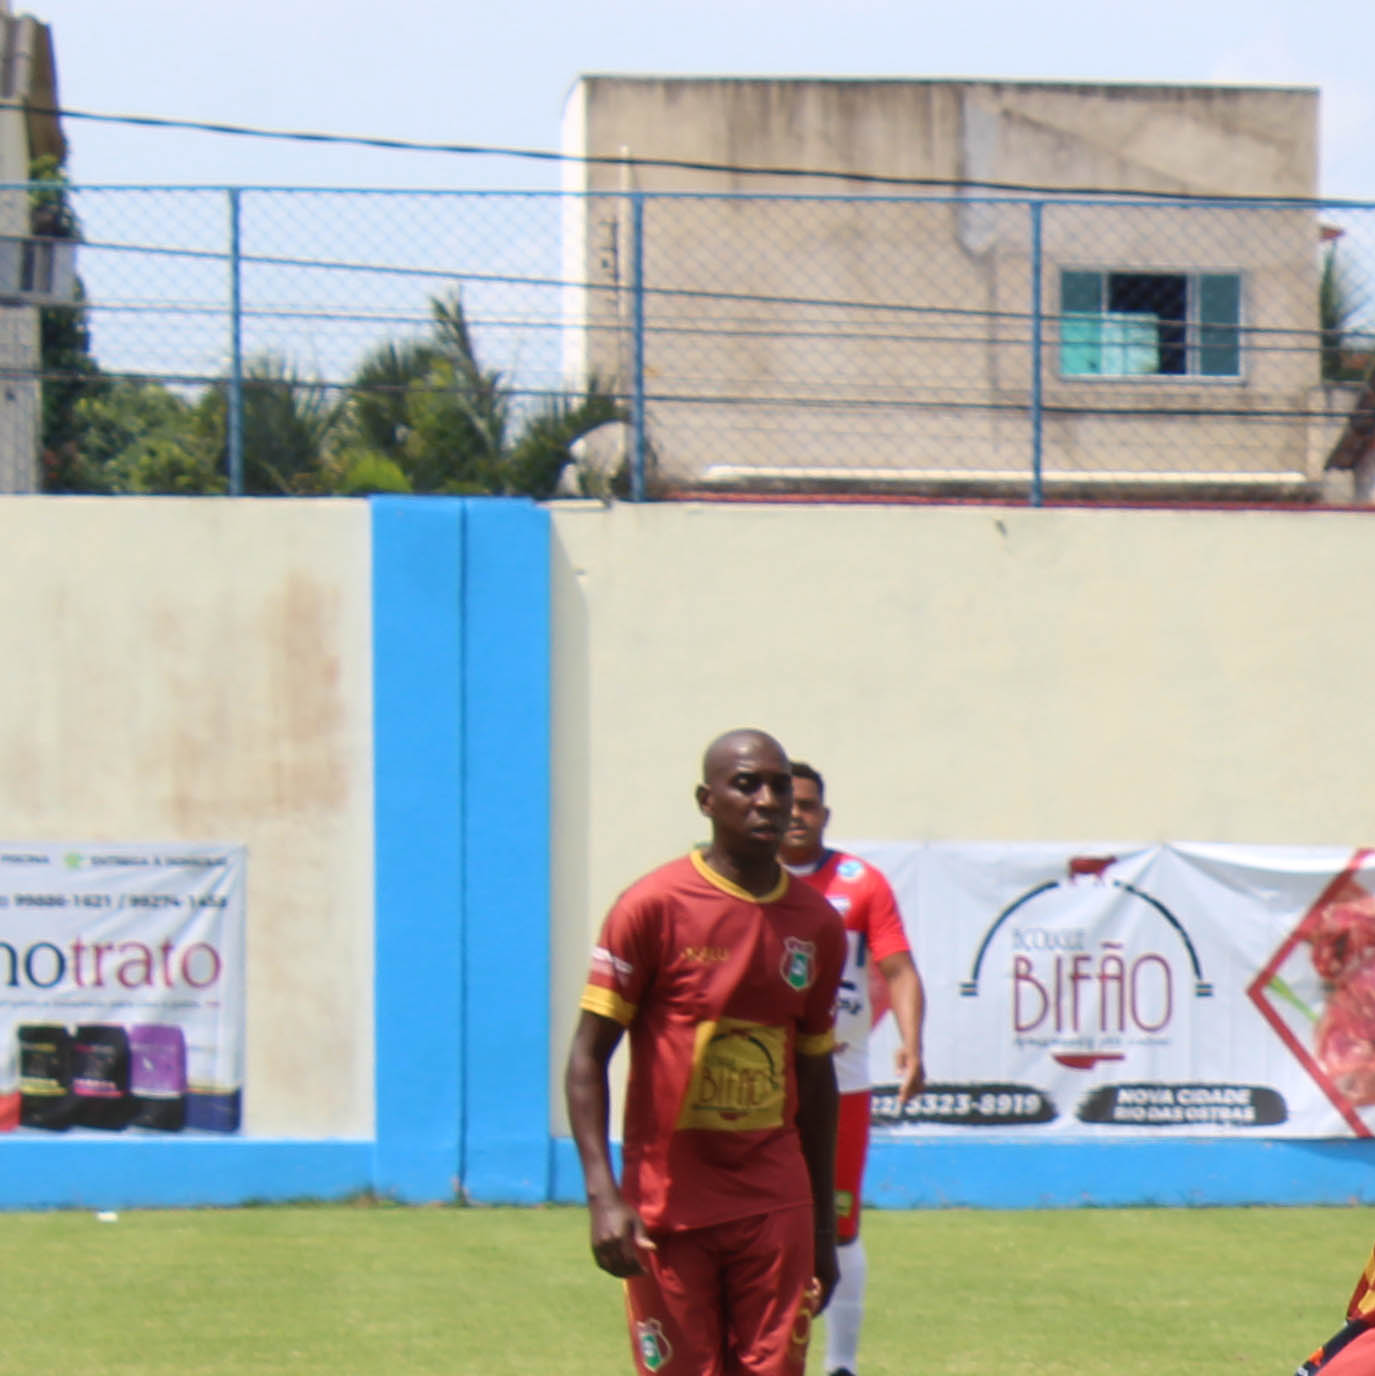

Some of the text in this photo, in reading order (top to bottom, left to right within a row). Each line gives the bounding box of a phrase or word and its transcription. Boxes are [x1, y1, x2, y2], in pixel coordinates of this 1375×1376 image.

[1014, 941, 1174, 1032] BIFÃO
[1117, 1087, 1251, 1105] NOVA CIDADE
